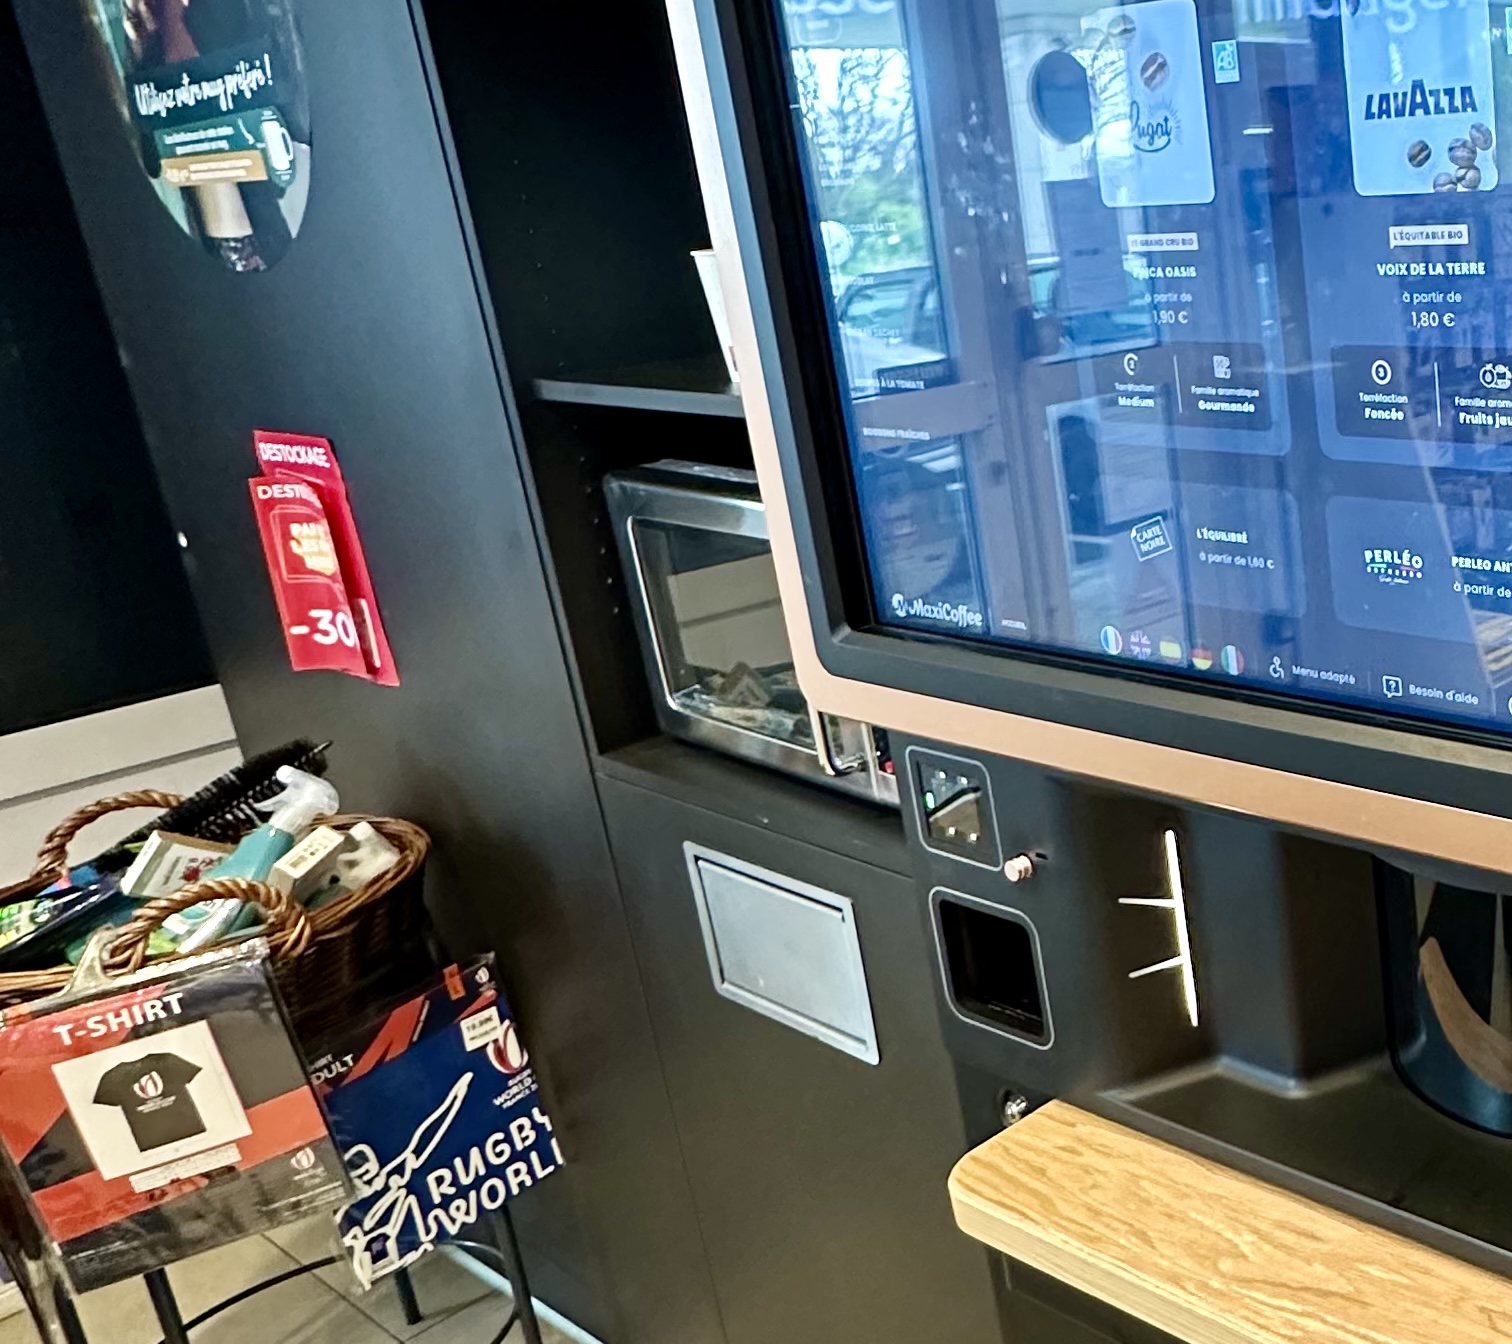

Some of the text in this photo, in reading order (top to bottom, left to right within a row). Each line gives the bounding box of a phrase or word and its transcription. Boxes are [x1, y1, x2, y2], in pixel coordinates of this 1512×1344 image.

[1364, 79, 1478, 121] LAVAZZA
[1447, 229, 1463, 240] BIO
[1165, 266, 1197, 278] OASIS
[1376, 262, 1486, 276] VOIX DE LA TERRE
[1153, 292, 1178, 304] partir
[1179, 292, 1193, 303] de
[1402, 290, 1462, 306] à partir de
[1152, 310, 1189, 325] 1,90 €
[1411, 311, 1456, 329] 1,80 €
[1454, 396, 1486, 408] Famille
[1459, 411, 1493, 426] Fruits
[258, 442, 331, 468] DESTOCKAGE
[1136, 525, 1162, 543] CARTE
[1207, 552, 1232, 565] partir
[1233, 555, 1247, 567] de
[1363, 548, 1424, 569] PERLÉO
[1451, 555, 1492, 571] PERLEO
[1453, 581, 1462, 592] à
[1463, 582, 1495, 597] partir
[1496, 585, 1512, 598] de
[909, 597, 984, 628] MaxiCoffee
[1291, 664, 1319, 679] Menu
[1408, 683, 1479, 706] Besoin d'aide
[52, 992, 184, 1046] T-SHIRT
[310, 1053, 355, 1085] DULT
[492, 1076, 533, 1106] WORLD
